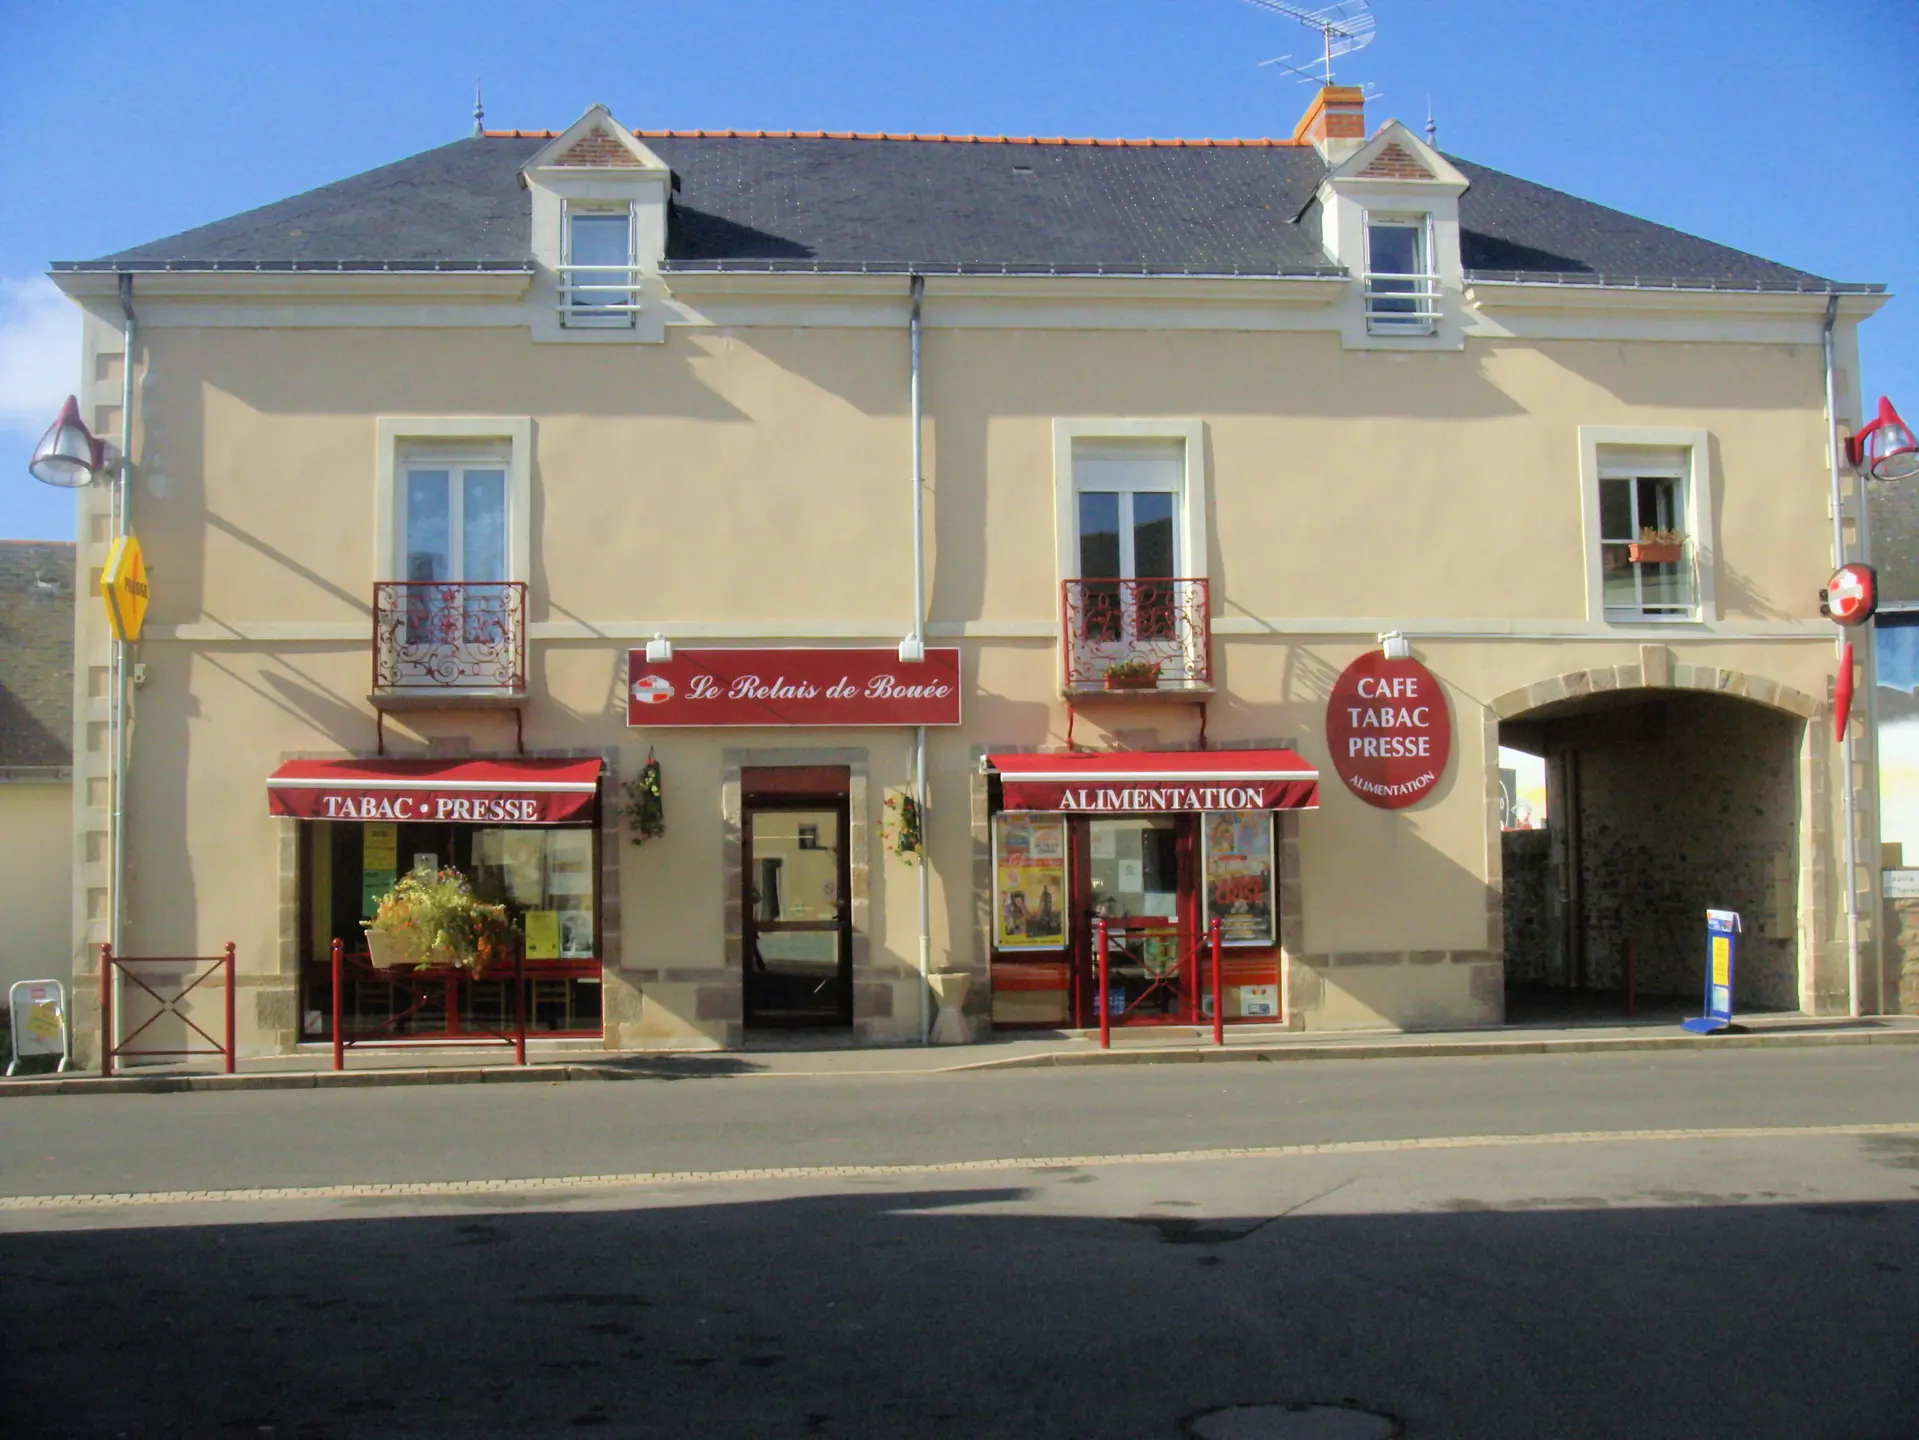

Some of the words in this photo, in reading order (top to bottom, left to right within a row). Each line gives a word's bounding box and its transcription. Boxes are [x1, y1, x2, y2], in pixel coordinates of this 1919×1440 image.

[685, 675, 723, 699] Le
[728, 675, 823, 699] Relais
[826, 676, 860, 699] de
[864, 675, 954, 699] Bouée
[1357, 677, 1418, 698] CAFE
[1347, 706, 1429, 728] TABAC
[1348, 736, 1430, 757] PRESSE
[1349, 770, 1435, 796] ALIMENTATION
[323, 796, 413, 818] TABAC
[435, 798, 537, 821] PRESSE
[1059, 787, 1264, 810] ALIMENTATION
